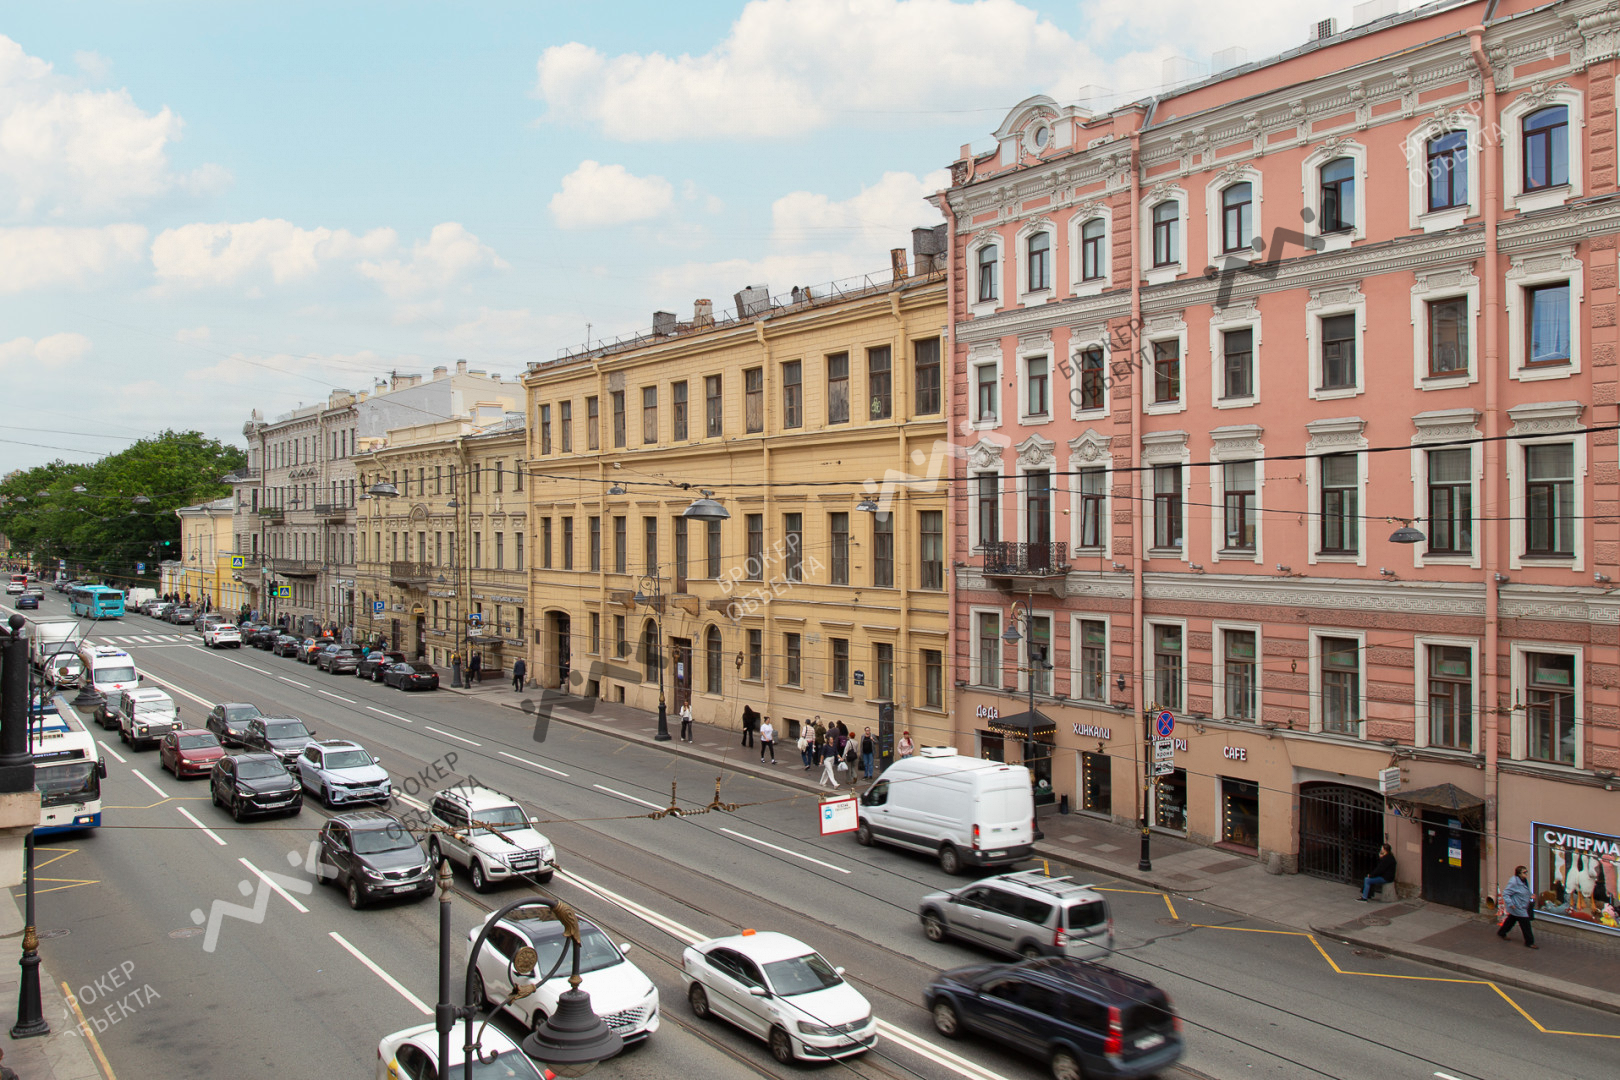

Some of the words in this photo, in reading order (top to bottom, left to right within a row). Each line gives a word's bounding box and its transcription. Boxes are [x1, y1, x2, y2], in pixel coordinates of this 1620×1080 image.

[1072, 722, 1111, 740] ХИНКАЛИ
[1223, 746, 1247, 761] CAFE
[1543, 830, 1620, 857] СУПЕРМА
